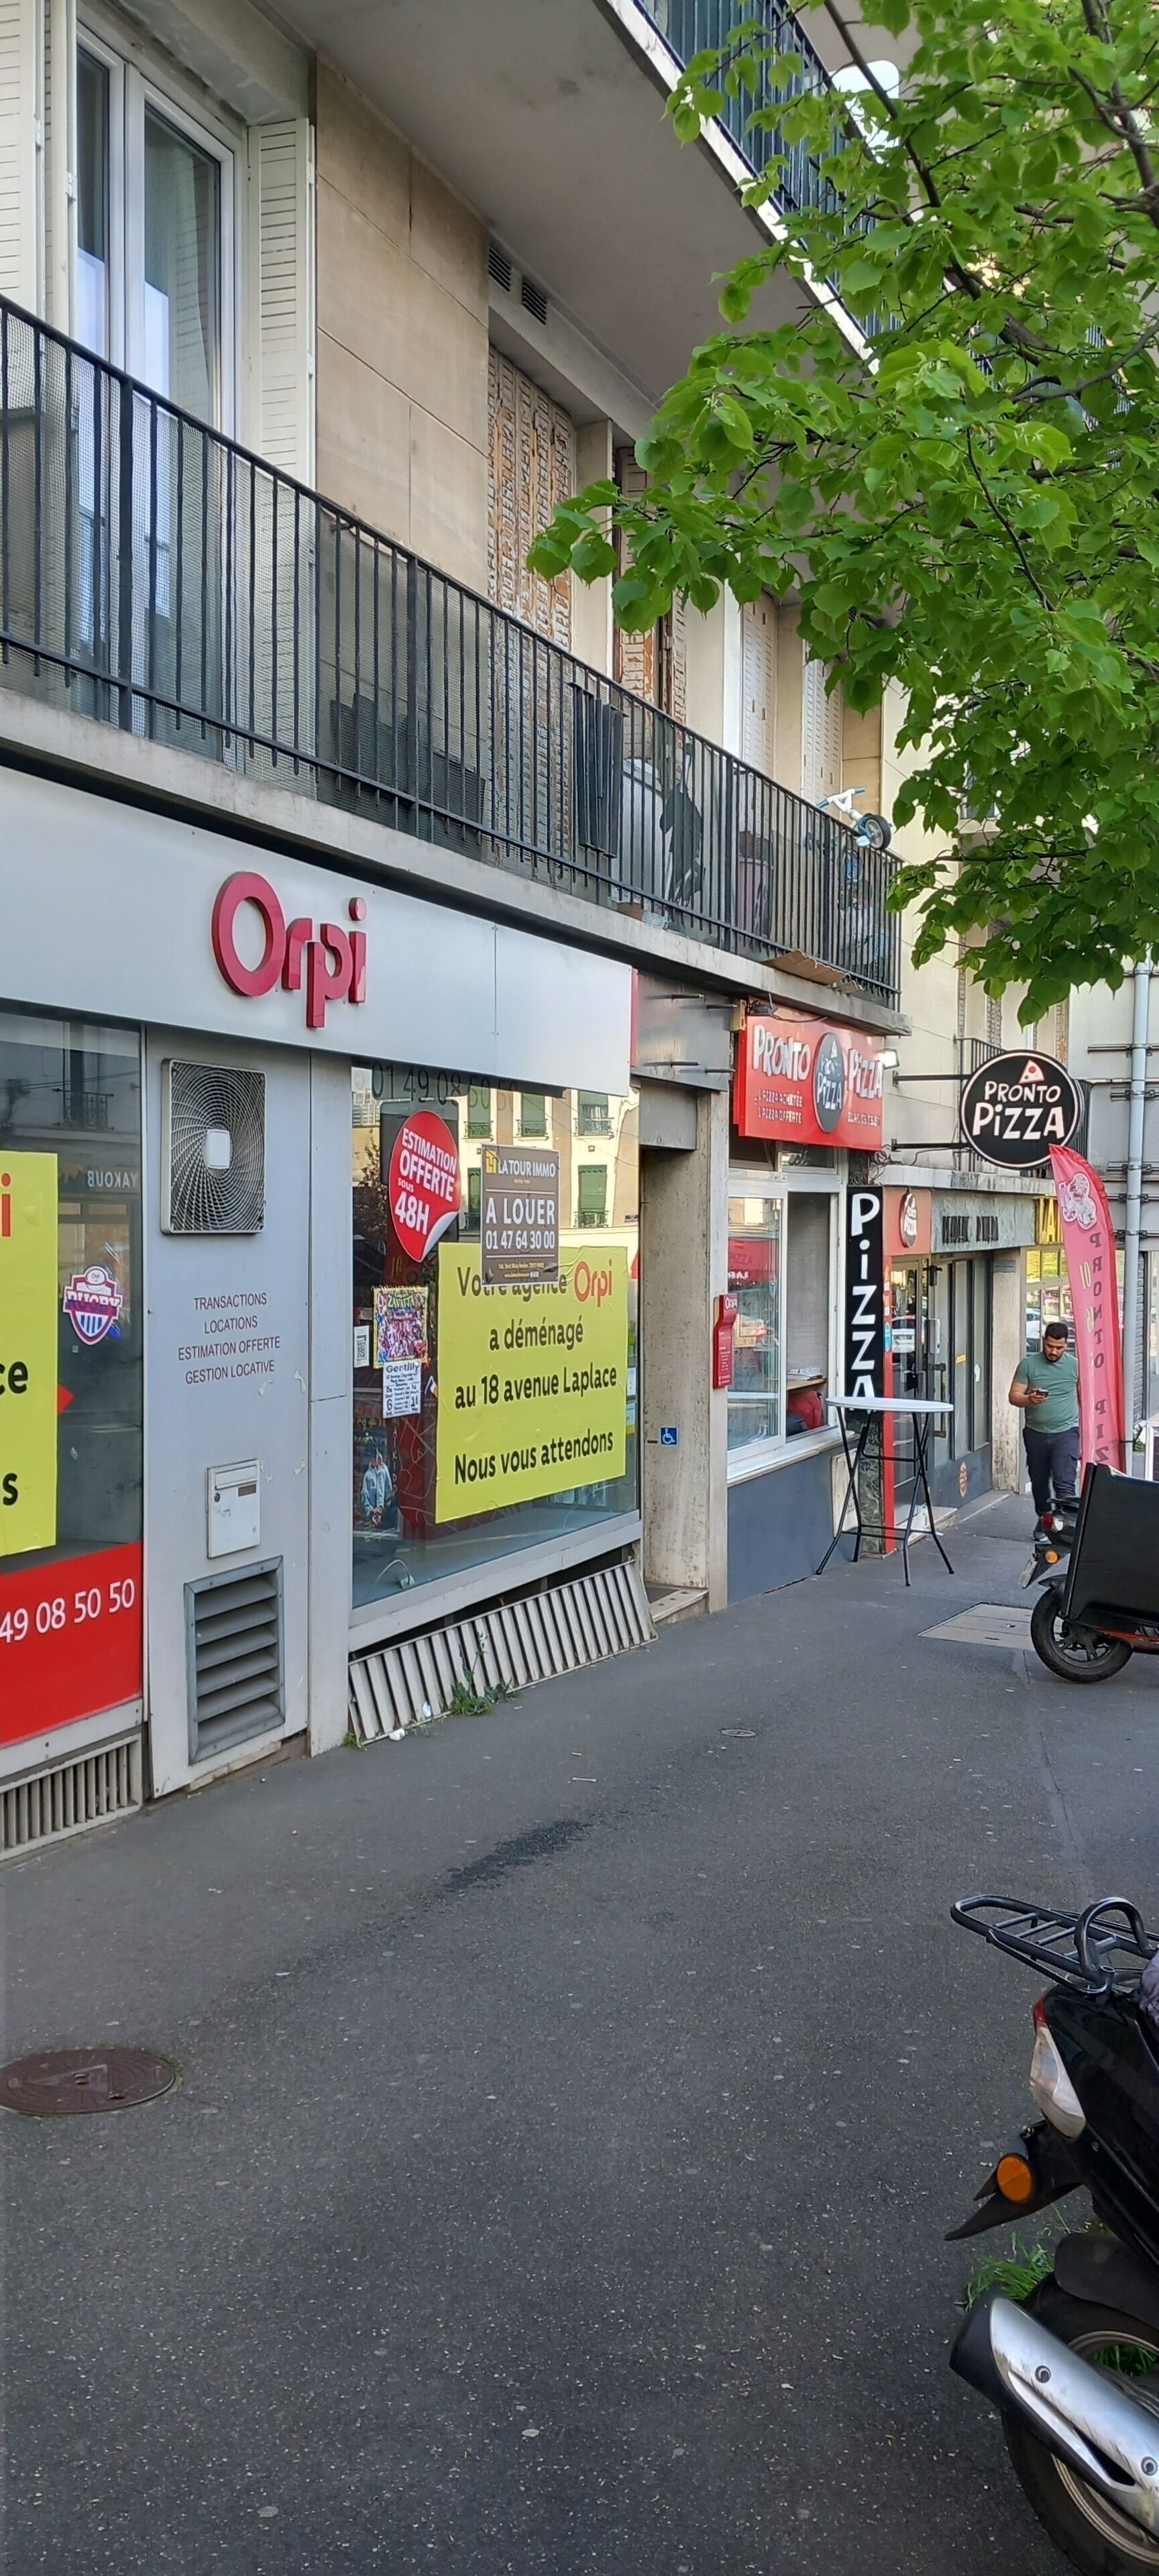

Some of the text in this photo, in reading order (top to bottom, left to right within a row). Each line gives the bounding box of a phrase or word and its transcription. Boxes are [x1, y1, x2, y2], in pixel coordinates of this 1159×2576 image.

[211, 871, 367, 1028] Orpi
[753, 1024, 811, 1081] PRONTO
[372, 1063, 394, 1099] 01
[403, 1065, 429, 1102] 49
[985, 1081, 1061, 1104] PRONTO
[402, 1127, 457, 1175] ESTIMATION
[400, 1148, 455, 1203] OFFERTE
[533, 1162, 555, 1178] IMMO
[395, 1191, 429, 1236] 48H
[486, 1197, 555, 1225] A LOUER
[486, 1230, 555, 1250] 01 47 64 30 00
[575, 1258, 612, 1307] Orpi
[194, 1292, 268, 1311] TRANSACTIONS
[204, 1315, 258, 1334] LOCATIONS
[489, 1314, 584, 1350] a déménagé
[178, 1336, 280, 1360] ESTIMATION OFFERTE
[185, 1359, 275, 1384] GESTION LOCATIVE
[386, 1362, 419, 1373] Gentilly
[455, 1362, 617, 1409] au 18 avenue Laplace
[386, 1398, 392, 1411] 6
[455, 1428, 613, 1485] Nous vous attendons
[36, 1597, 66, 1633] 08
[74, 1587, 101, 1624] 50
[109, 1578, 135, 1613] 50
